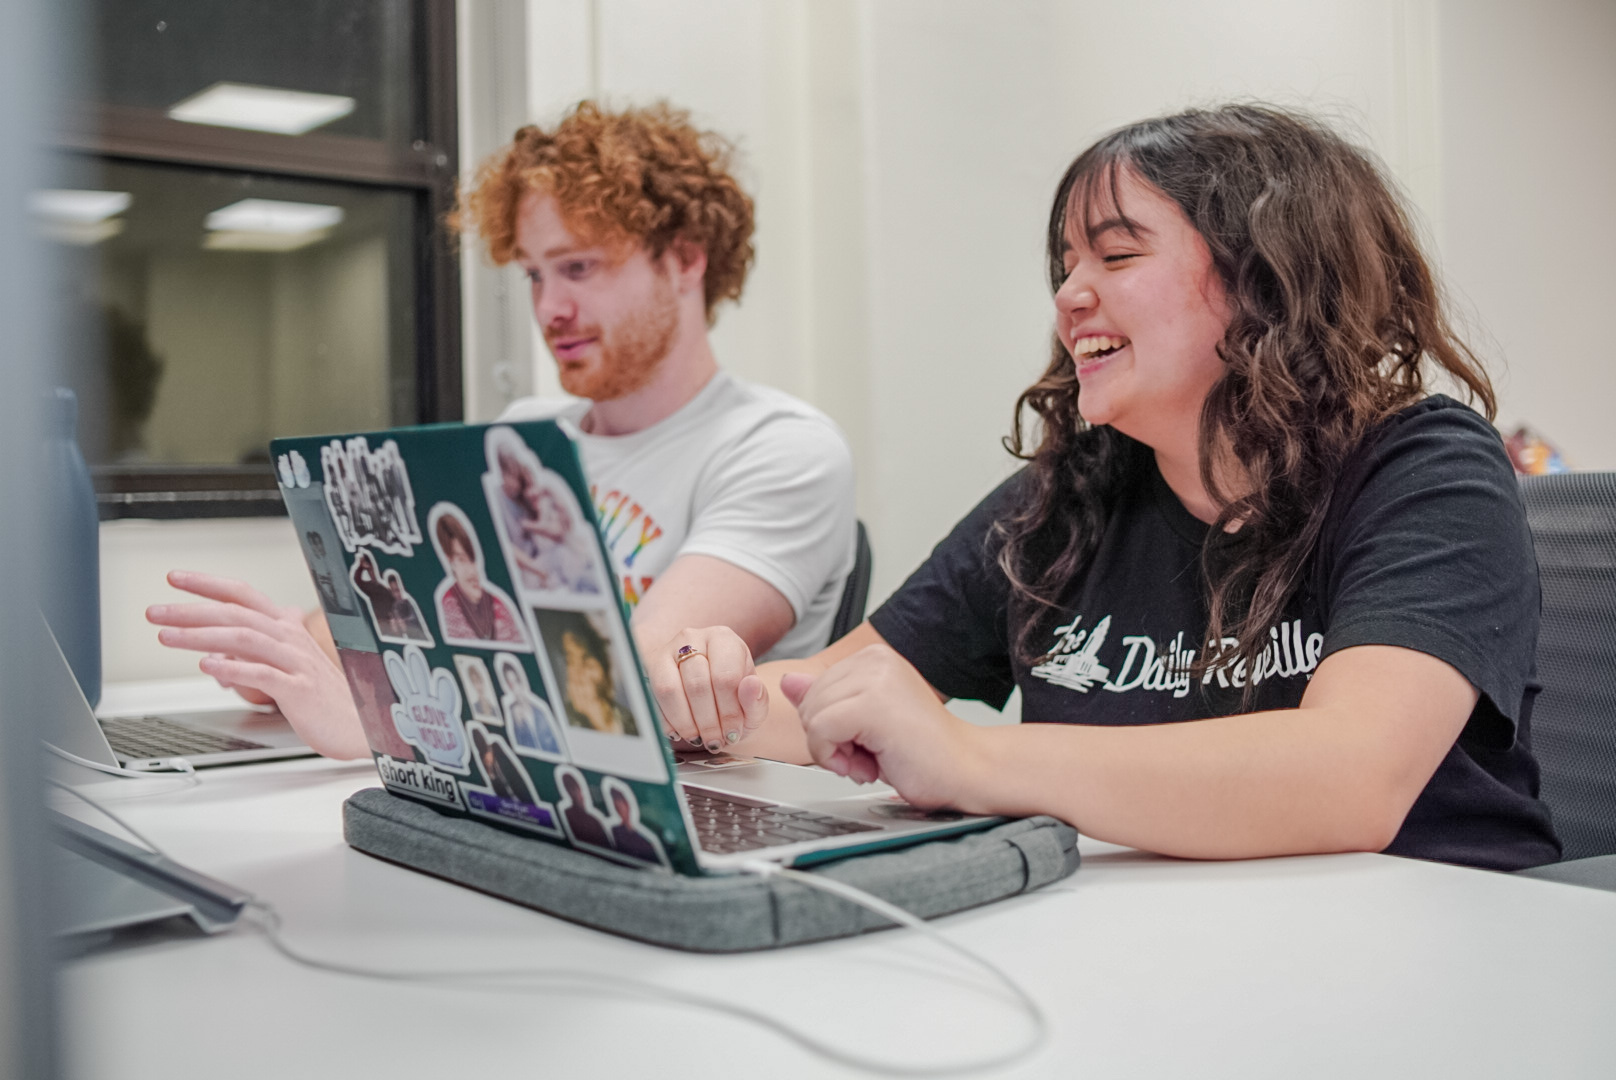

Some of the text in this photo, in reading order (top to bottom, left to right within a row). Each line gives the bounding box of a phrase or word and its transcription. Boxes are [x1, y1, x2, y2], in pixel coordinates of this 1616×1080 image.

[1047, 614, 1324, 698] The Daily Reveille
[411, 704, 451, 729] GLOVE
[382, 759, 419, 788] short
[421, 768, 456, 802] king
